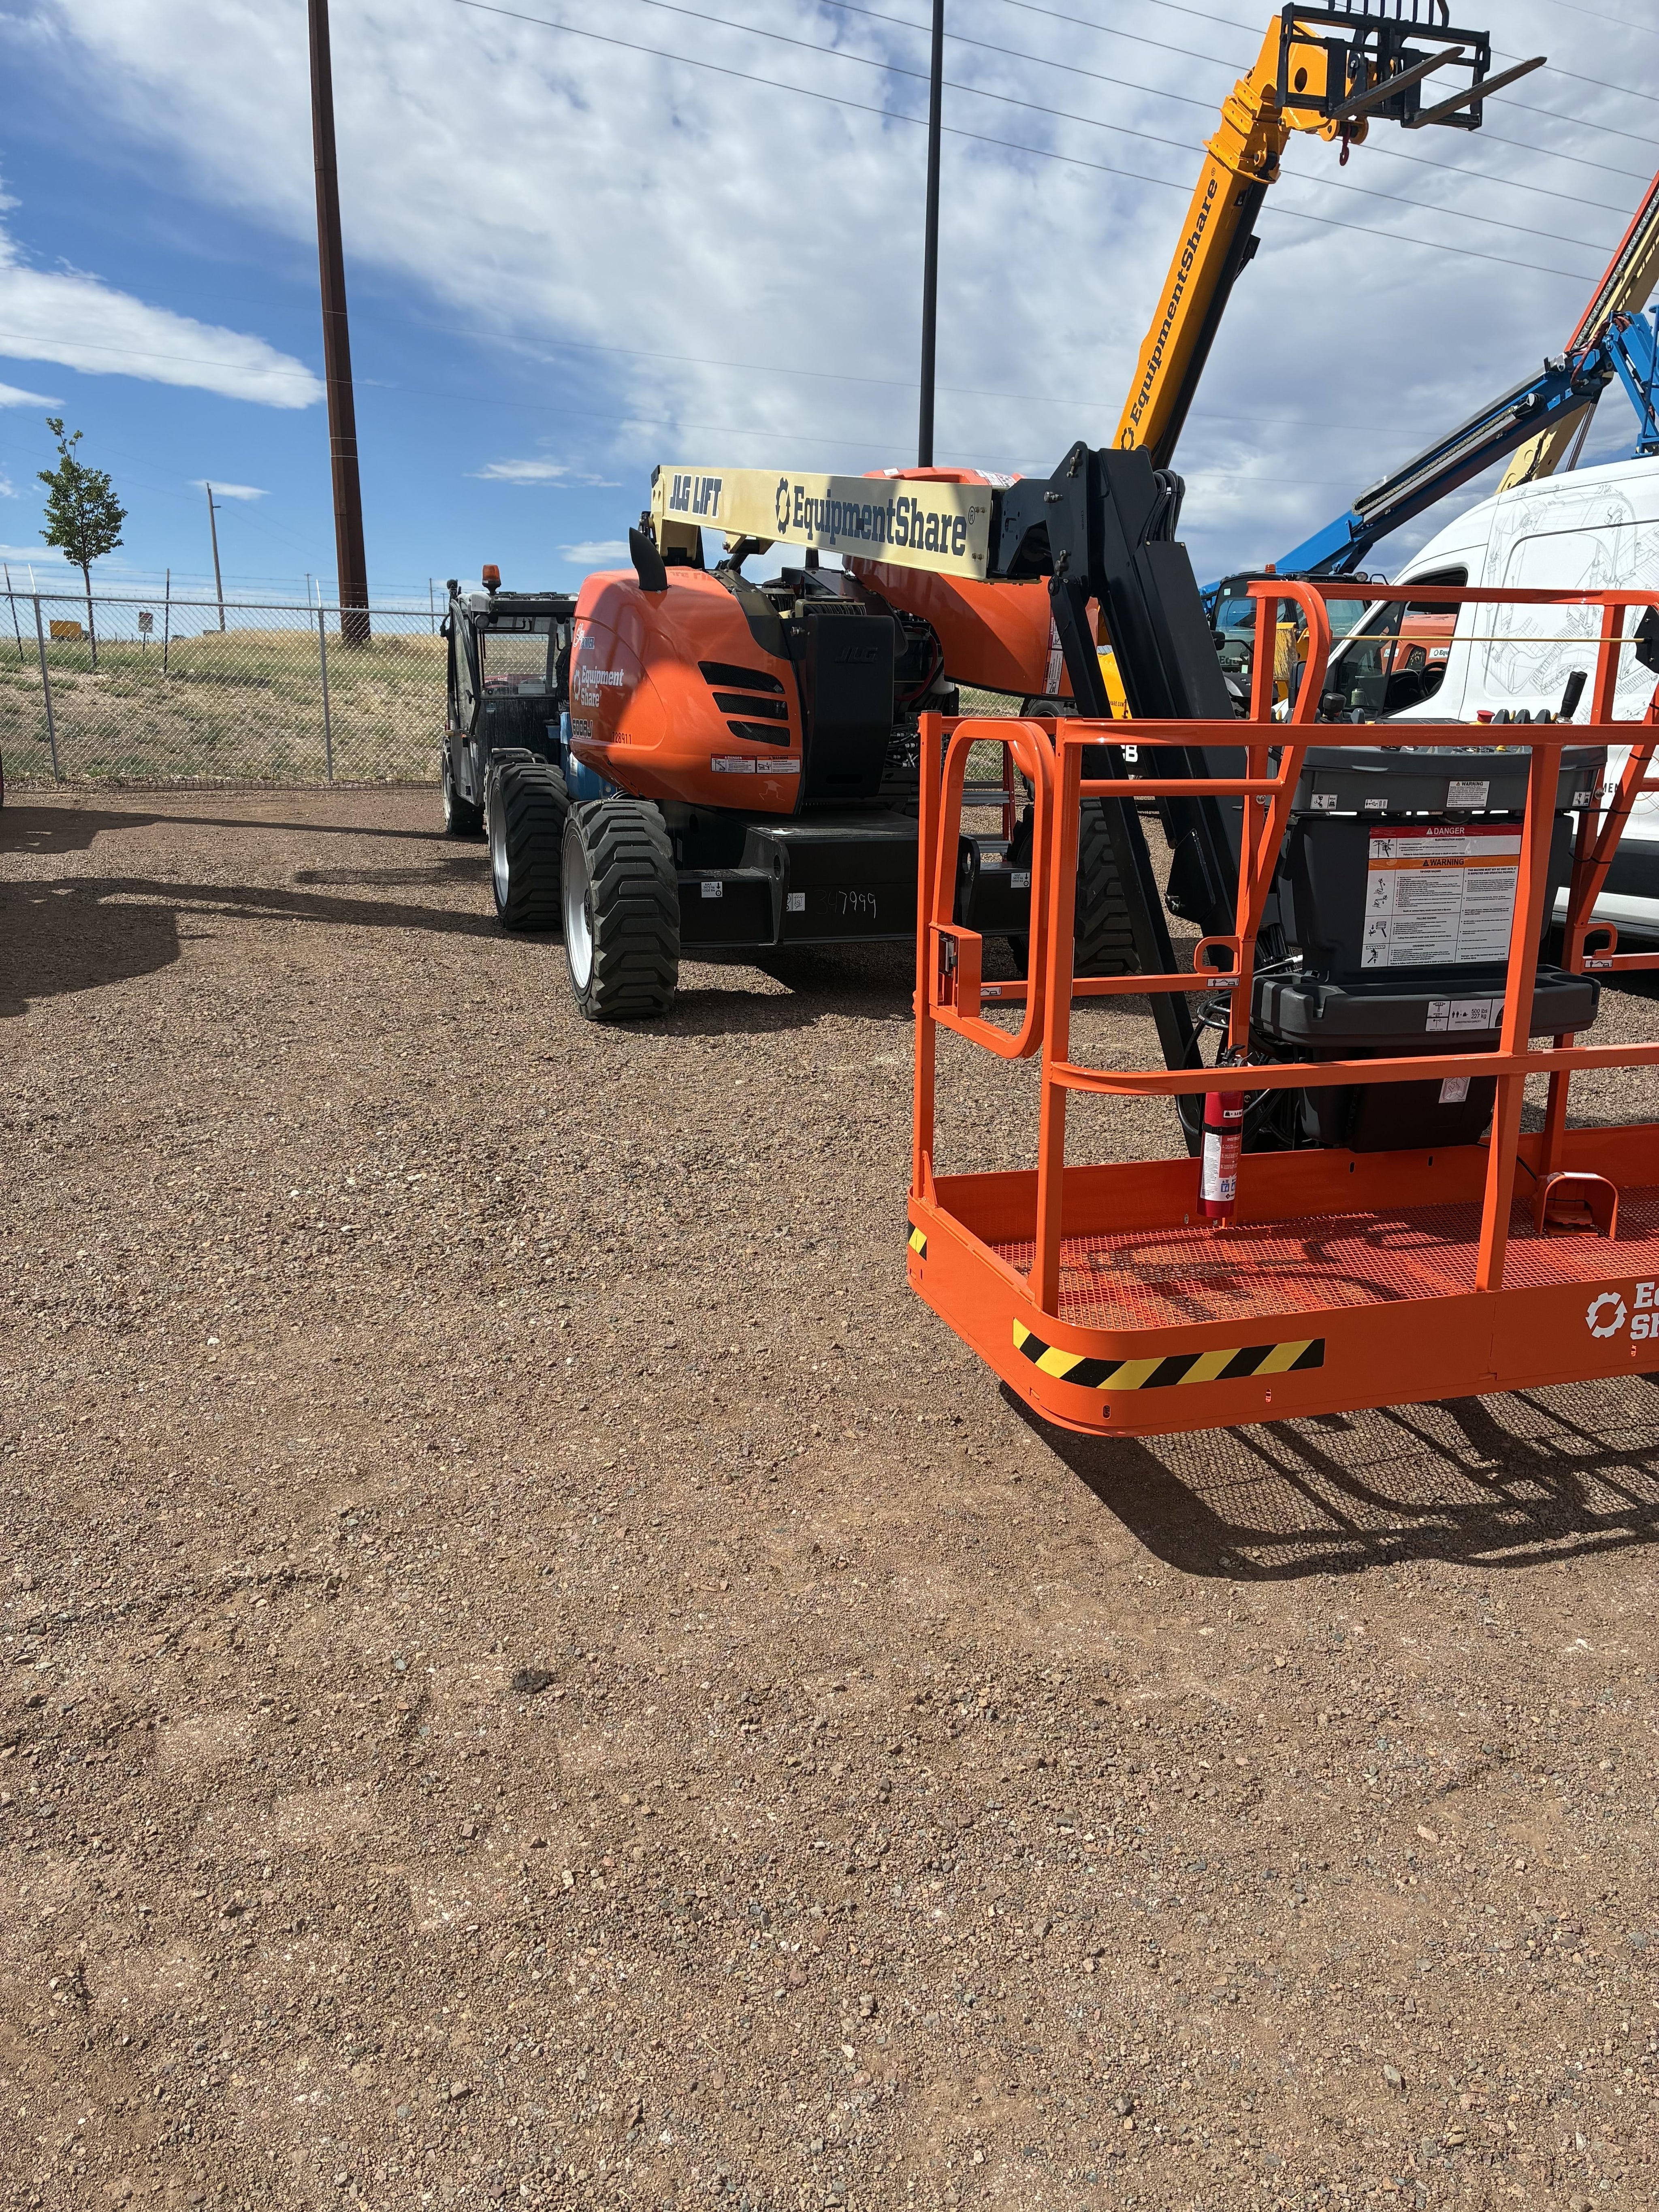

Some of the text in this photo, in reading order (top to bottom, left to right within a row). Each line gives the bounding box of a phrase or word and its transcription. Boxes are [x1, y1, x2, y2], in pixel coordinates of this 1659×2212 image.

[669, 475, 722, 516] JLG LIFT
[582, 666, 624, 689] Equipment
[581, 688, 599, 708] Share
[612, 732, 631, 744] 728911
[1633, 1282, 1659, 1309] E
